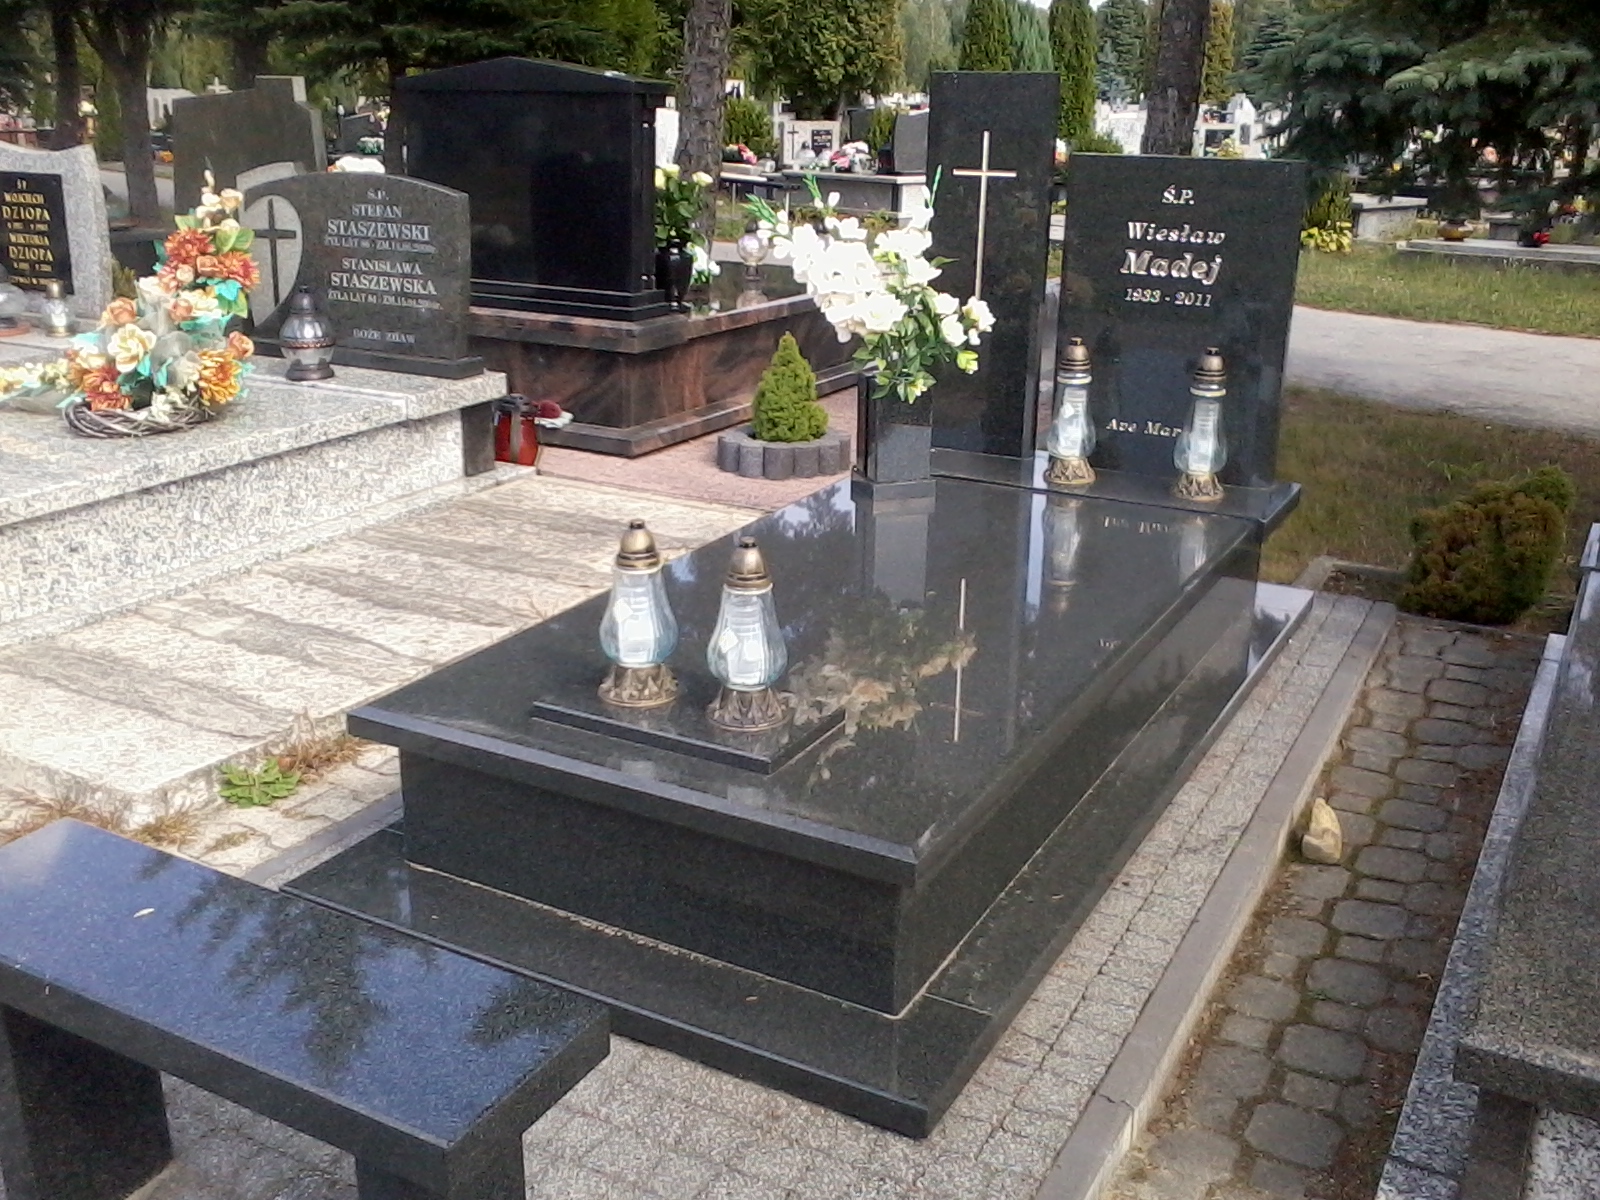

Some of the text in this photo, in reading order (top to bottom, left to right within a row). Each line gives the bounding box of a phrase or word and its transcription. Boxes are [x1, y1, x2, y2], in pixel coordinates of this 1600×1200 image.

[1161, 184, 1195, 204] Ś.P.
[352, 203, 402, 218] STEFAN
[327, 219, 431, 241] STASZEWSKI
[1127, 221, 1226, 245] Wiesław
[1120, 250, 1223, 286] Madej
[330, 272, 437, 295] STASZEWSKA
[1174, 291, 1212, 308] 2011
[1106, 418, 1182, 438] Ave Mar
